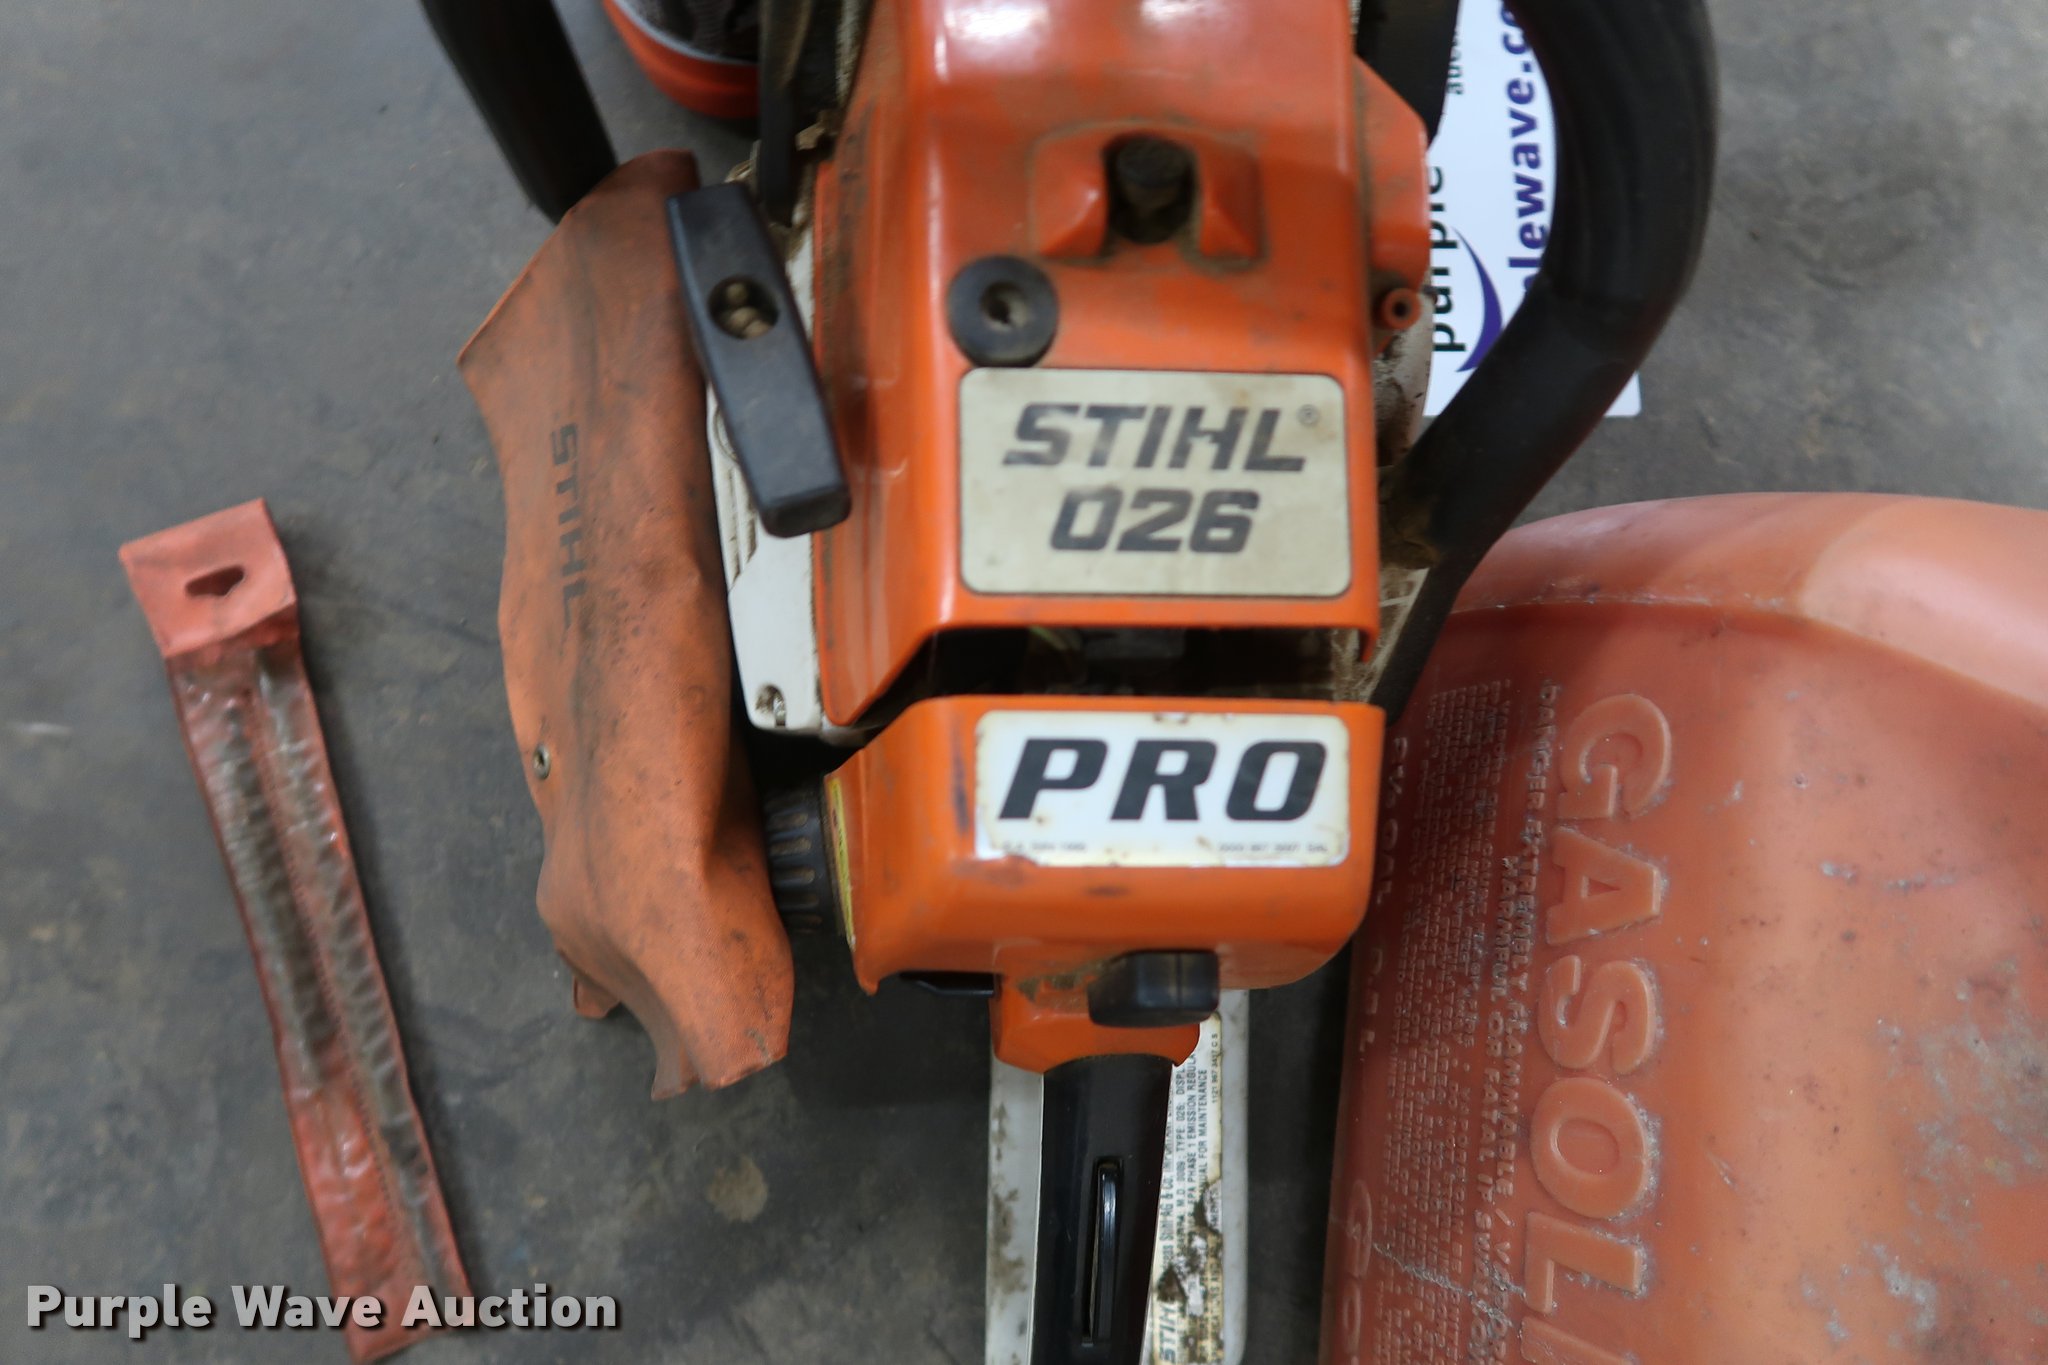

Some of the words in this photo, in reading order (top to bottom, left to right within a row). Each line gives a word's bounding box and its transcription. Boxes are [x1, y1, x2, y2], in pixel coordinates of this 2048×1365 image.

[1002, 402, 1305, 473] STIHL
[551, 422, 590, 630] STIHL
[1049, 487, 1261, 555] 026
[998, 738, 1328, 822] PRO
[1527, 684, 1559, 810] DANGER
[1489, 854, 1518, 1002] HARMFUL
[1508, 819, 1545, 991] EXTREMELY
[1485, 1011, 1504, 1058] OR
[1185, 1094, 1197, 1139] EMISSION
[1196, 1069, 1208, 1136] MAINTENANCE
[1479, 1067, 1499, 1162] FATAL
[1495, 1003, 1526, 1197] FLAMMABLE
[1185, 1151, 1196, 1182] PHASE
[1198, 1140, 1207, 1158] FOR
[1476, 1173, 1492, 1203] IF
[1157, 1300, 1178, 1363] STIH
[1488, 1241, 1511, 1365] VAPOR
